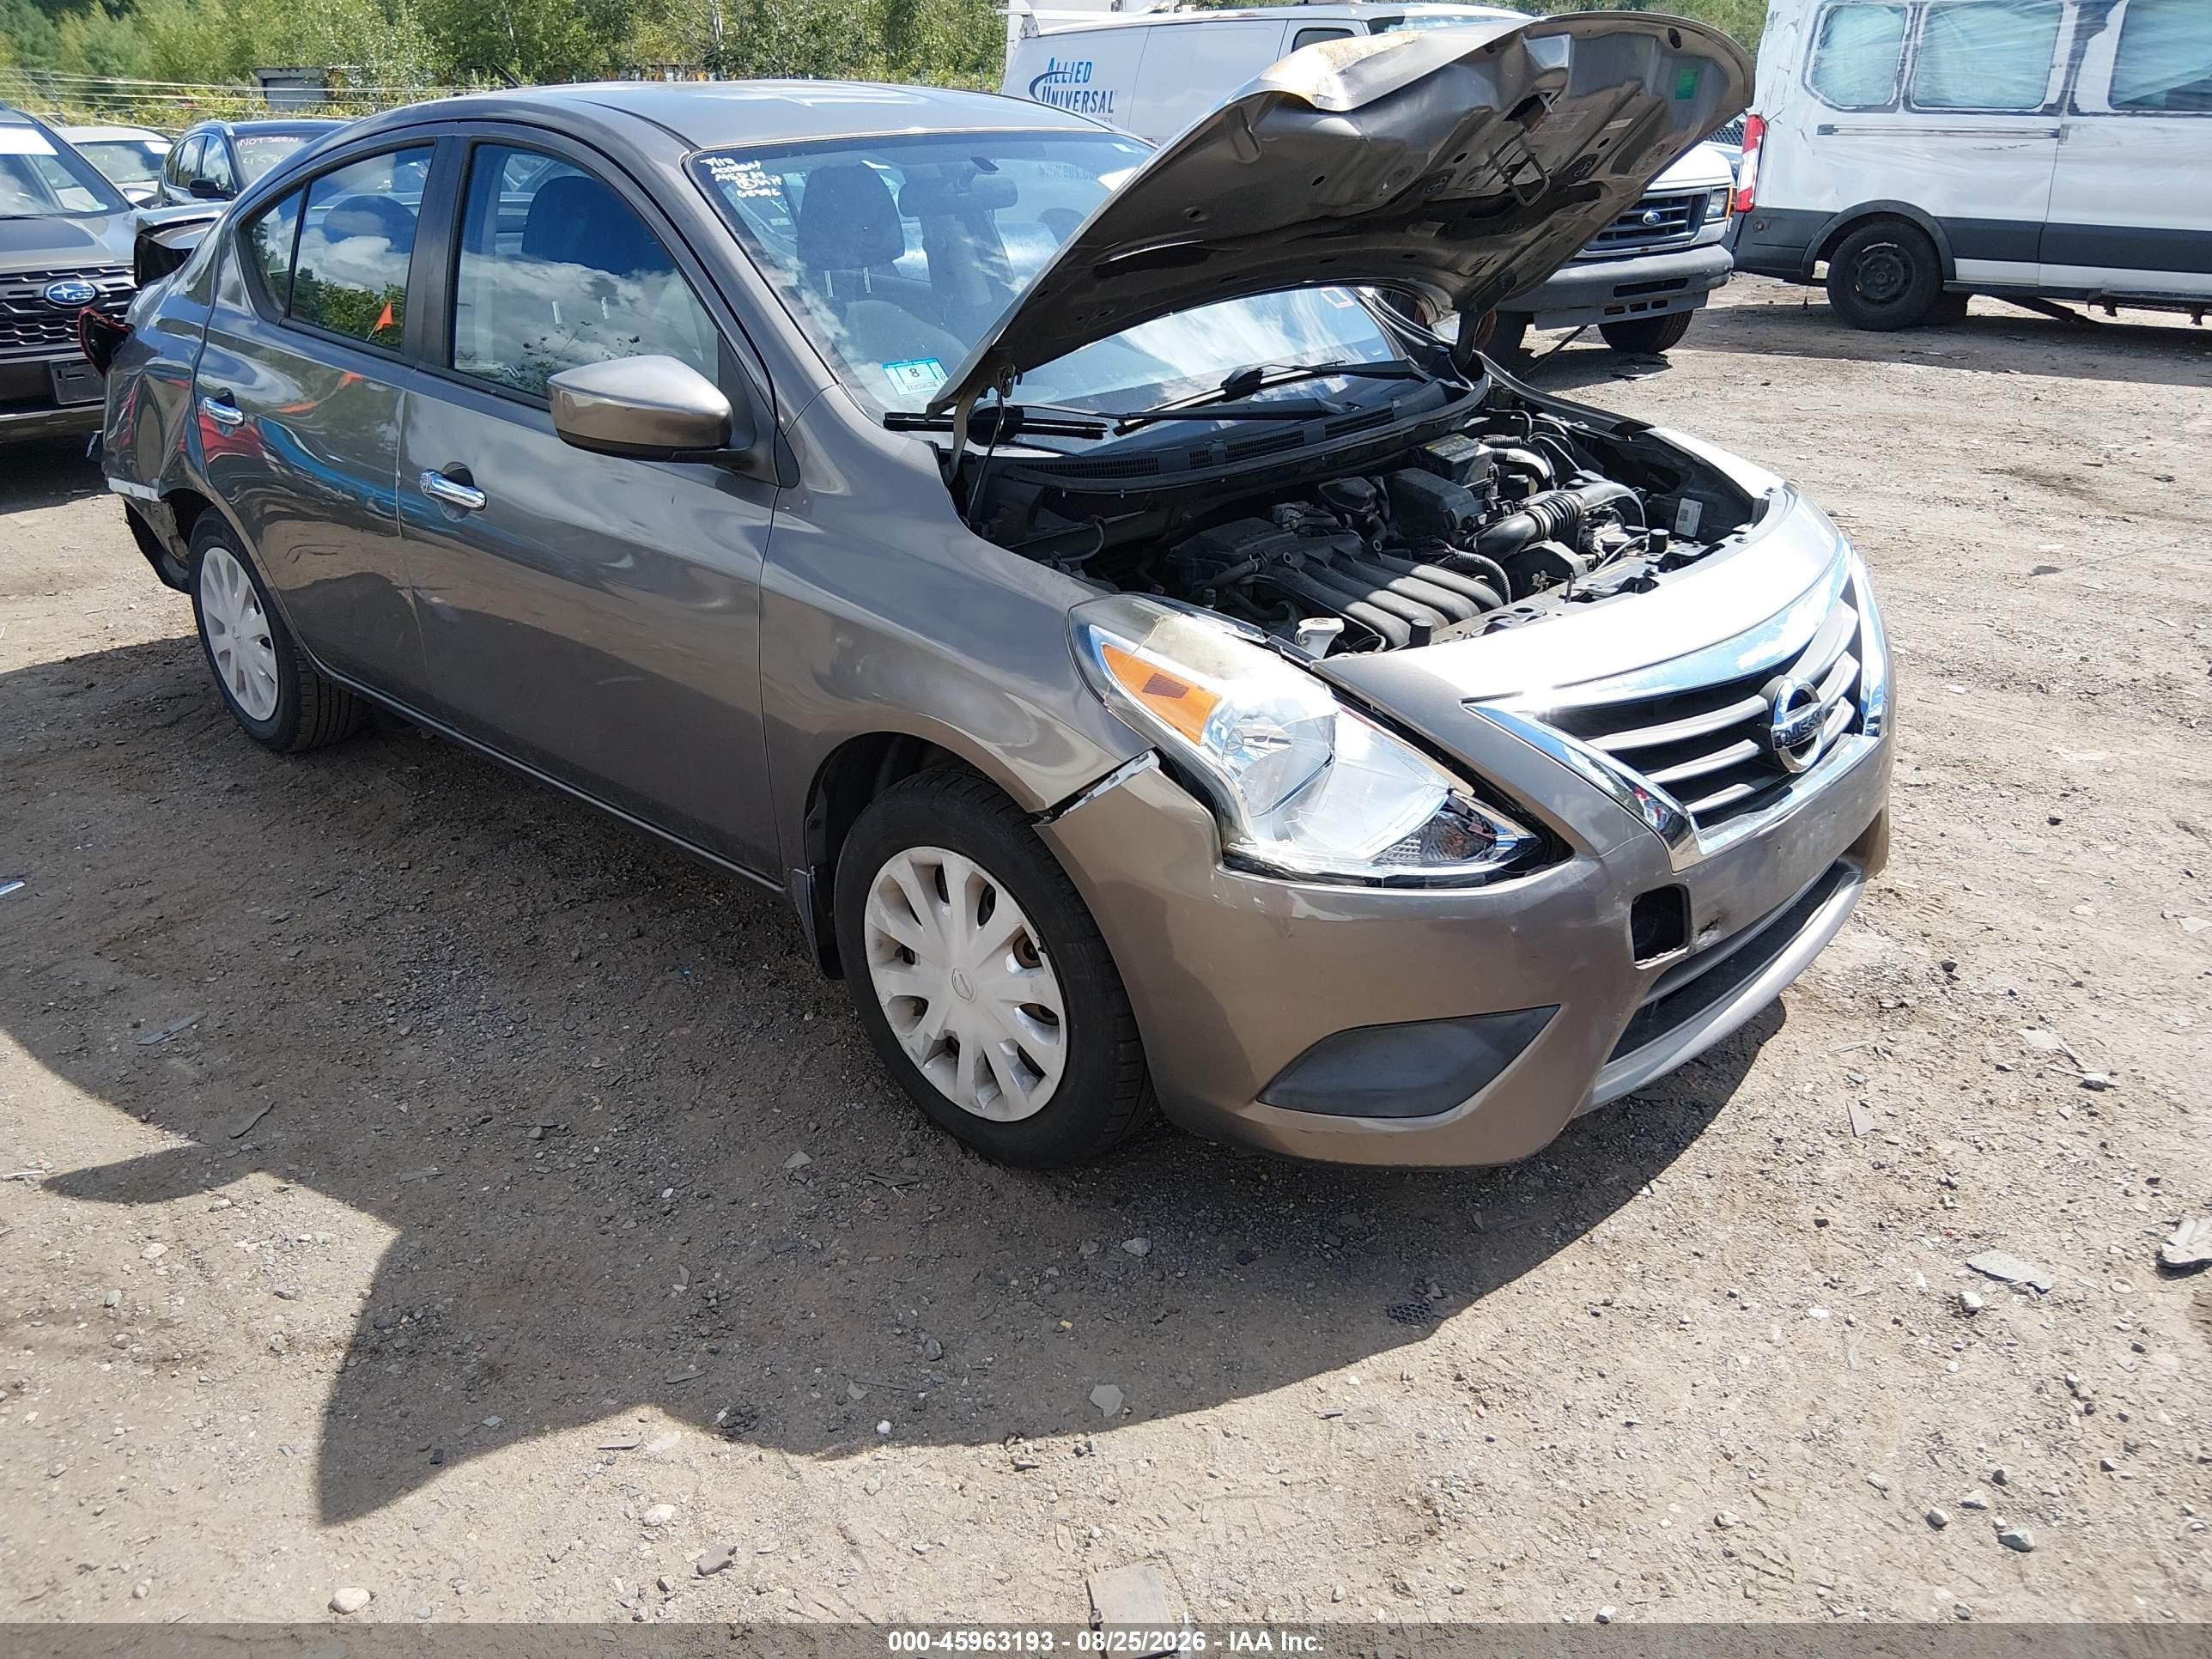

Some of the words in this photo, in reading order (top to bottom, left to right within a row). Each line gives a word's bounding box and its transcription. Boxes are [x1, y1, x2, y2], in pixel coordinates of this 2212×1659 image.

[1045, 57, 1092, 83] ALLIED
[1042, 85, 1114, 114] UNIVERSAL
[240, 137, 264, 147] NOT
[909, 368, 921, 377] 8
